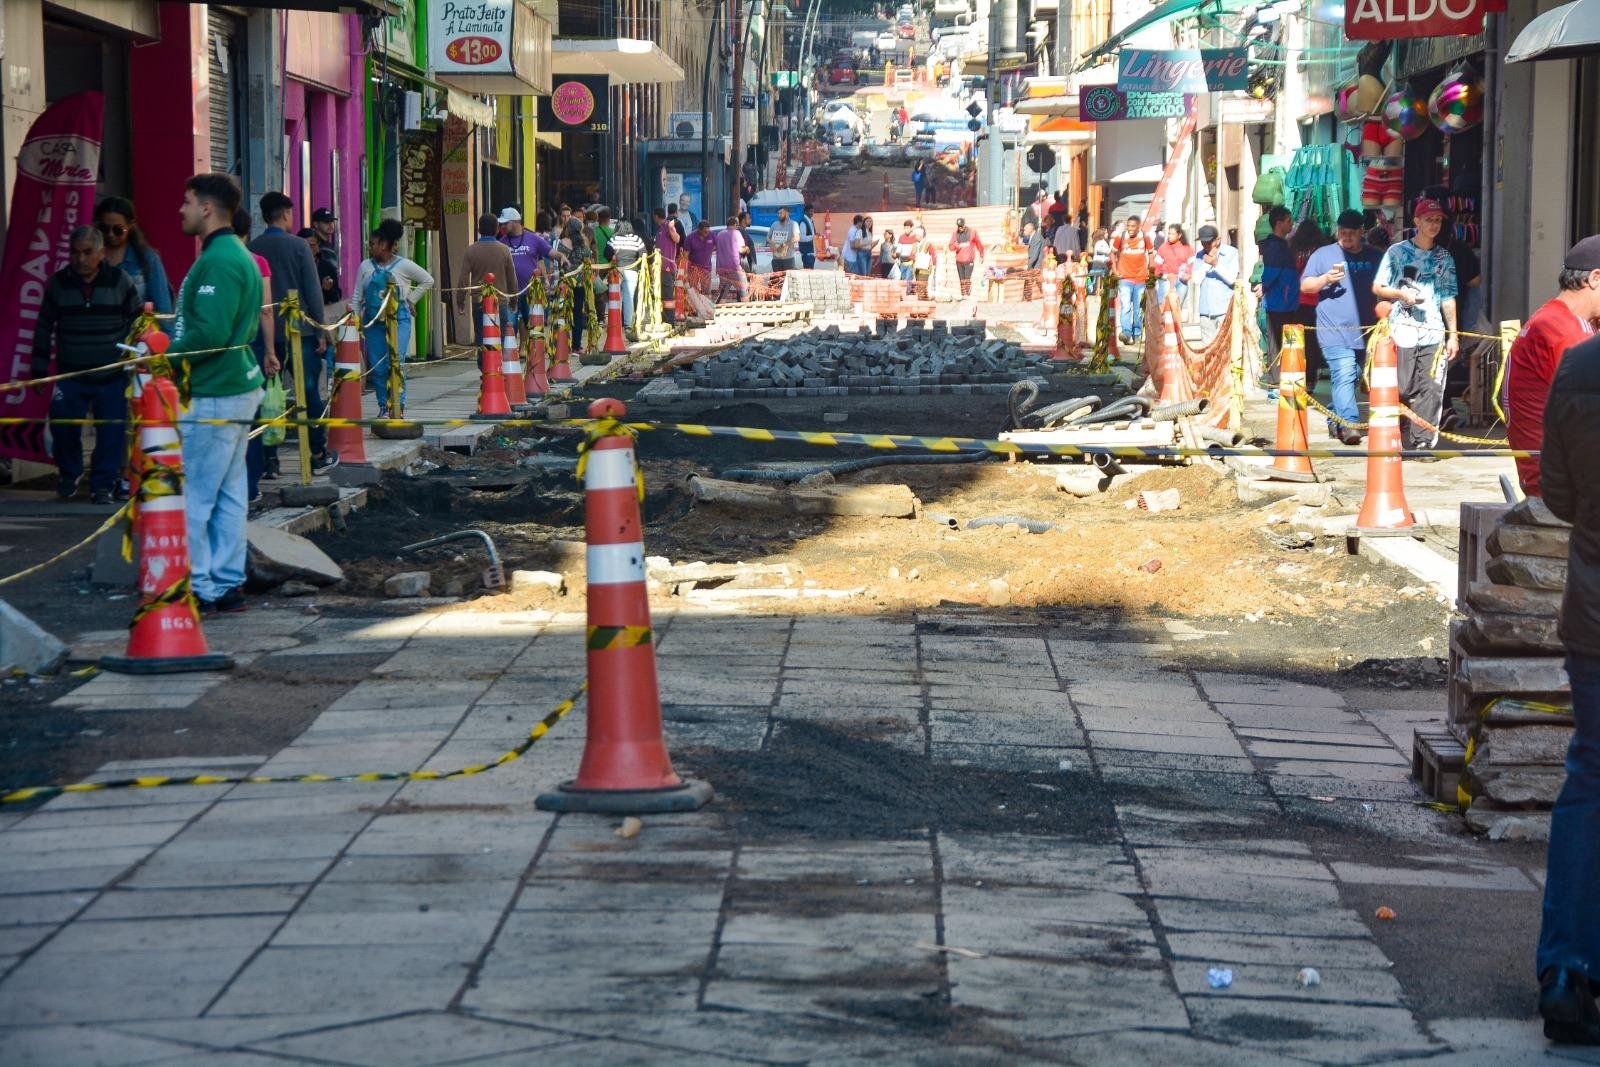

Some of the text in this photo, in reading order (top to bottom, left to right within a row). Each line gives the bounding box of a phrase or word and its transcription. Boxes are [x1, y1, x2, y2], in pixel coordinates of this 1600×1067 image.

[441, 2, 507, 20] Prato Feito
[1352, 0, 1477, 24] ALDO
[446, 21, 503, 36] A Laminuta
[1122, 50, 1247, 89] Lingerie
[1174, 97, 1184, 105] DE
[1126, 104, 1185, 118] ATACADO
